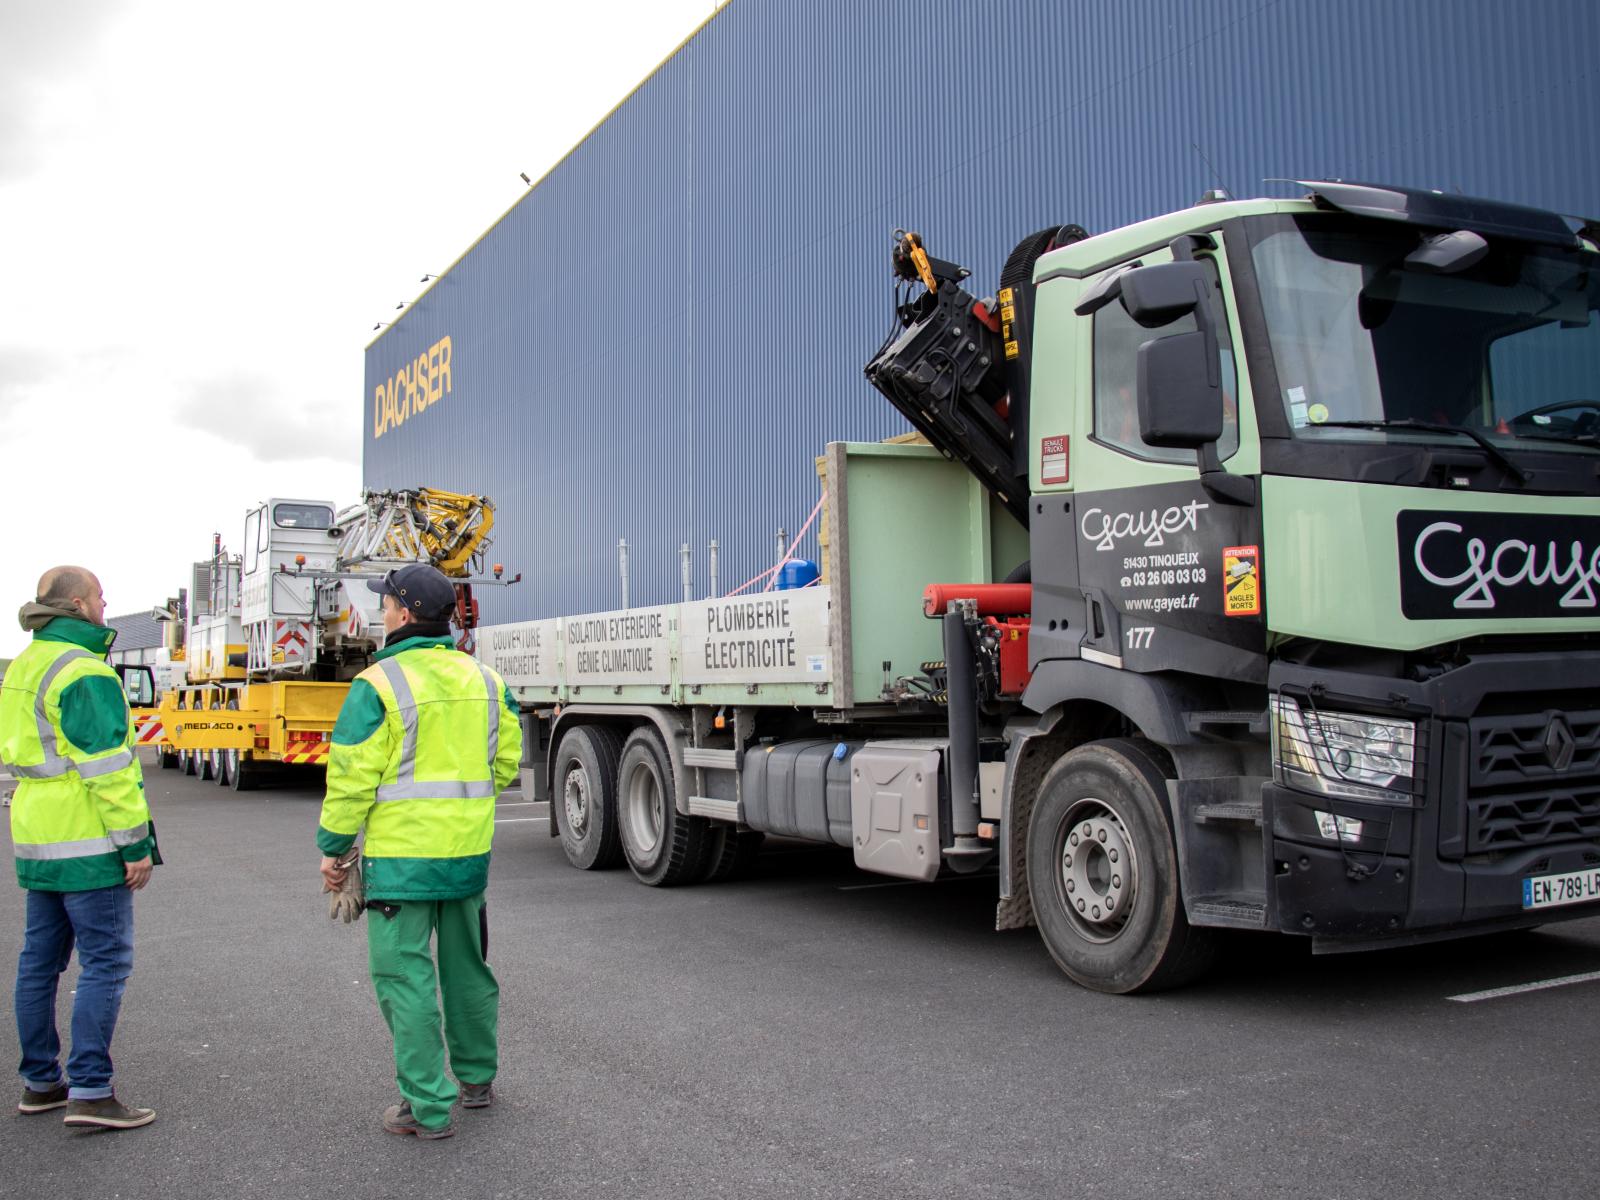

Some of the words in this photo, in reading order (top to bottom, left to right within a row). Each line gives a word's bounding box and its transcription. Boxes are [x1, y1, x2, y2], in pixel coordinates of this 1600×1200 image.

[374, 335, 452, 439] DACHSER
[1081, 499, 1209, 551] Gayet
[1123, 556, 1147, 569] 51430
[1149, 552, 1199, 567] TINQUEUX
[1133, 572, 1146, 586] 03
[1147, 571, 1160, 585] 26
[1161, 570, 1175, 584] 08
[1176, 568, 1190, 583] 03
[1191, 567, 1206, 583] 03
[1124, 593, 1199, 613] www.gayet.fr
[1229, 593, 1255, 602] ANGLES
[1230, 601, 1253, 609] MORTS
[568, 619, 607, 644] ISOLATION
[609, 611, 662, 641] EXTÉRIEURE
[708, 599, 790, 633] PLOMBERIE
[493, 627, 541, 650] COUVERTURE
[1126, 626, 1155, 649] 177
[577, 646, 599, 673] GÉNIE
[601, 647, 653, 673] CLIMATIQUE
[705, 630, 796, 669] ÉLECTRICITÉ
[184, 722, 234, 730] MEDIACO
